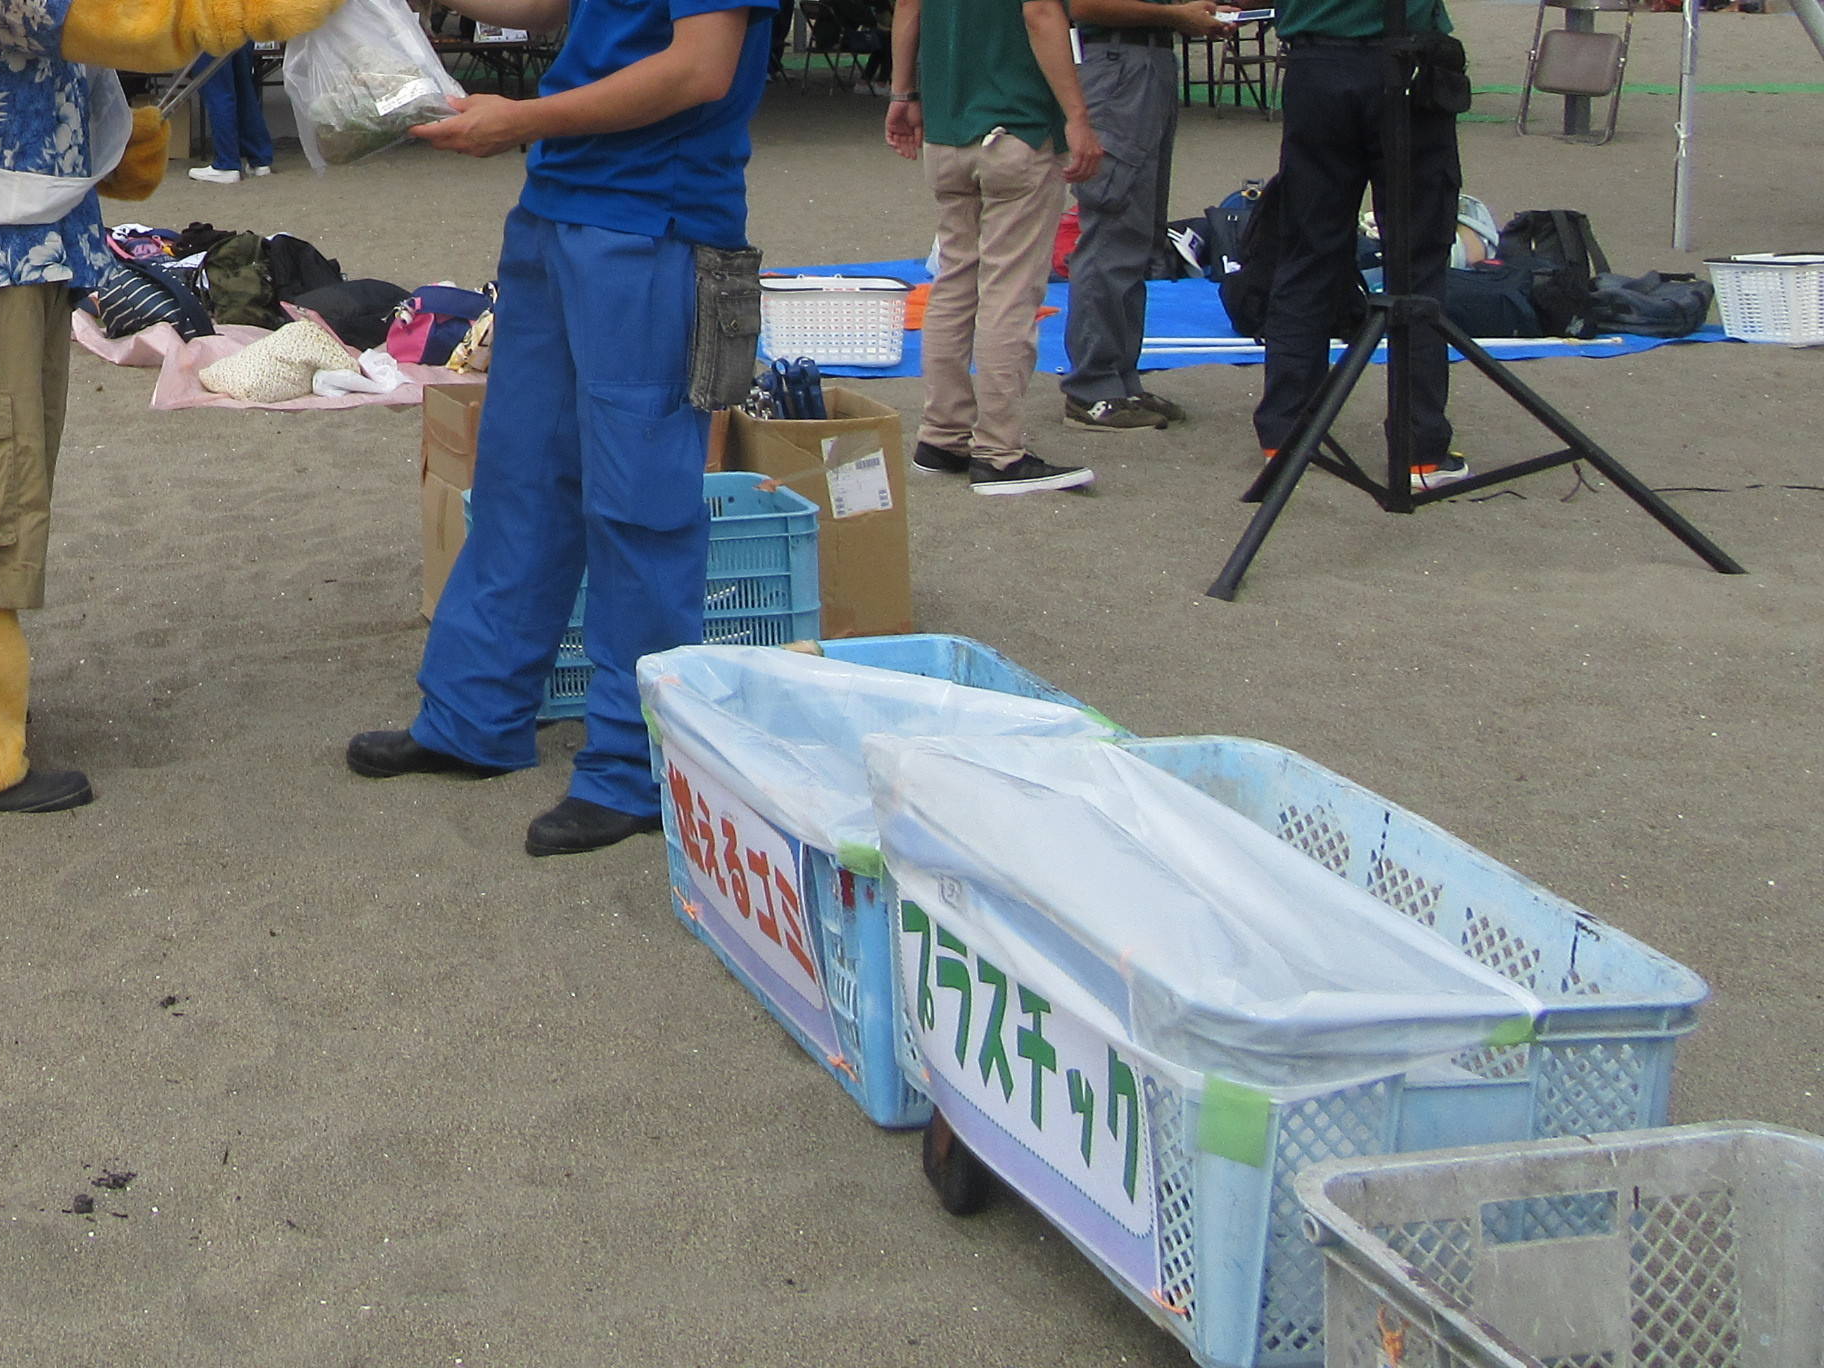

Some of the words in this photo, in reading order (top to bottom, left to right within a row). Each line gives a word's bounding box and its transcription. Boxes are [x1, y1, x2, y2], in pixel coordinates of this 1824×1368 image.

[668, 759, 818, 985] 燃えるゴミ
[901, 900, 1138, 1205] プラスチック
